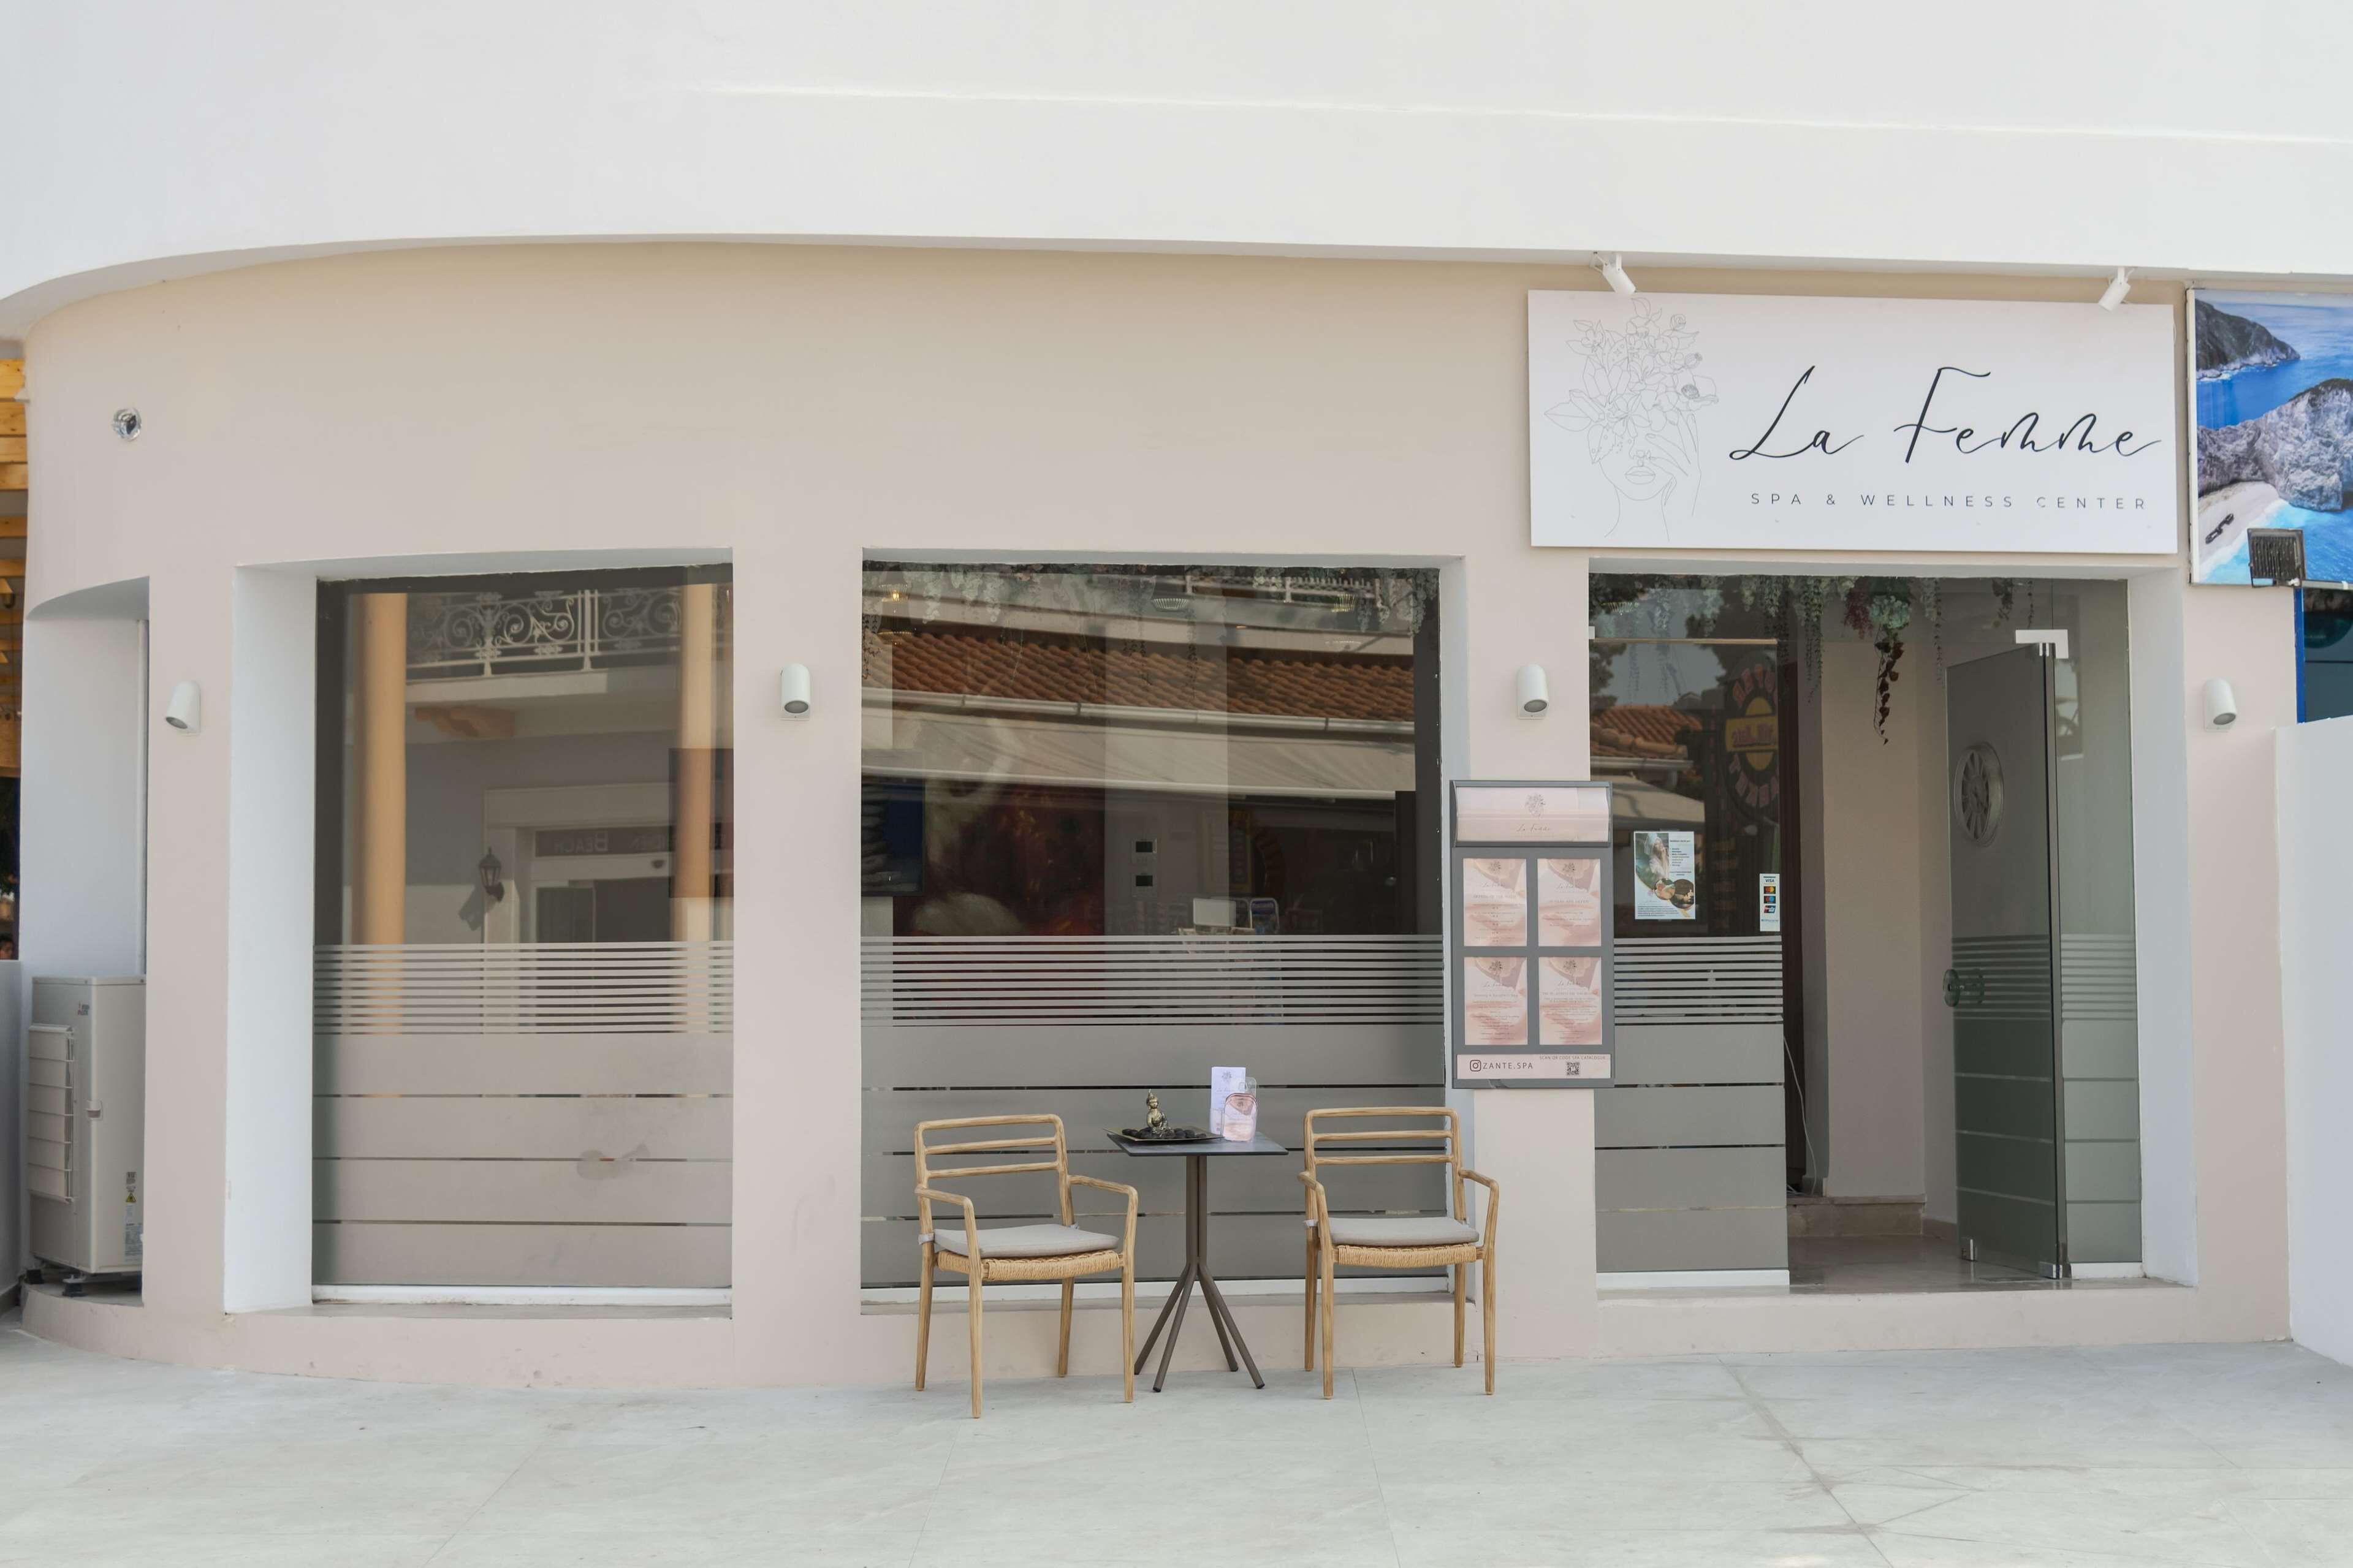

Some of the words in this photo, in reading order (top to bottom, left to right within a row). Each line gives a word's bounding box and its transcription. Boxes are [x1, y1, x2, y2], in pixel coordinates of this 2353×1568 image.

[1729, 365, 1865, 460] La
[1893, 366, 2162, 464] Femme
[1750, 493, 1801, 506] SPA
[1826, 494, 1836, 506] &
[1860, 494, 2012, 507] WELLNESS
[2036, 496, 2145, 509] CENTER
